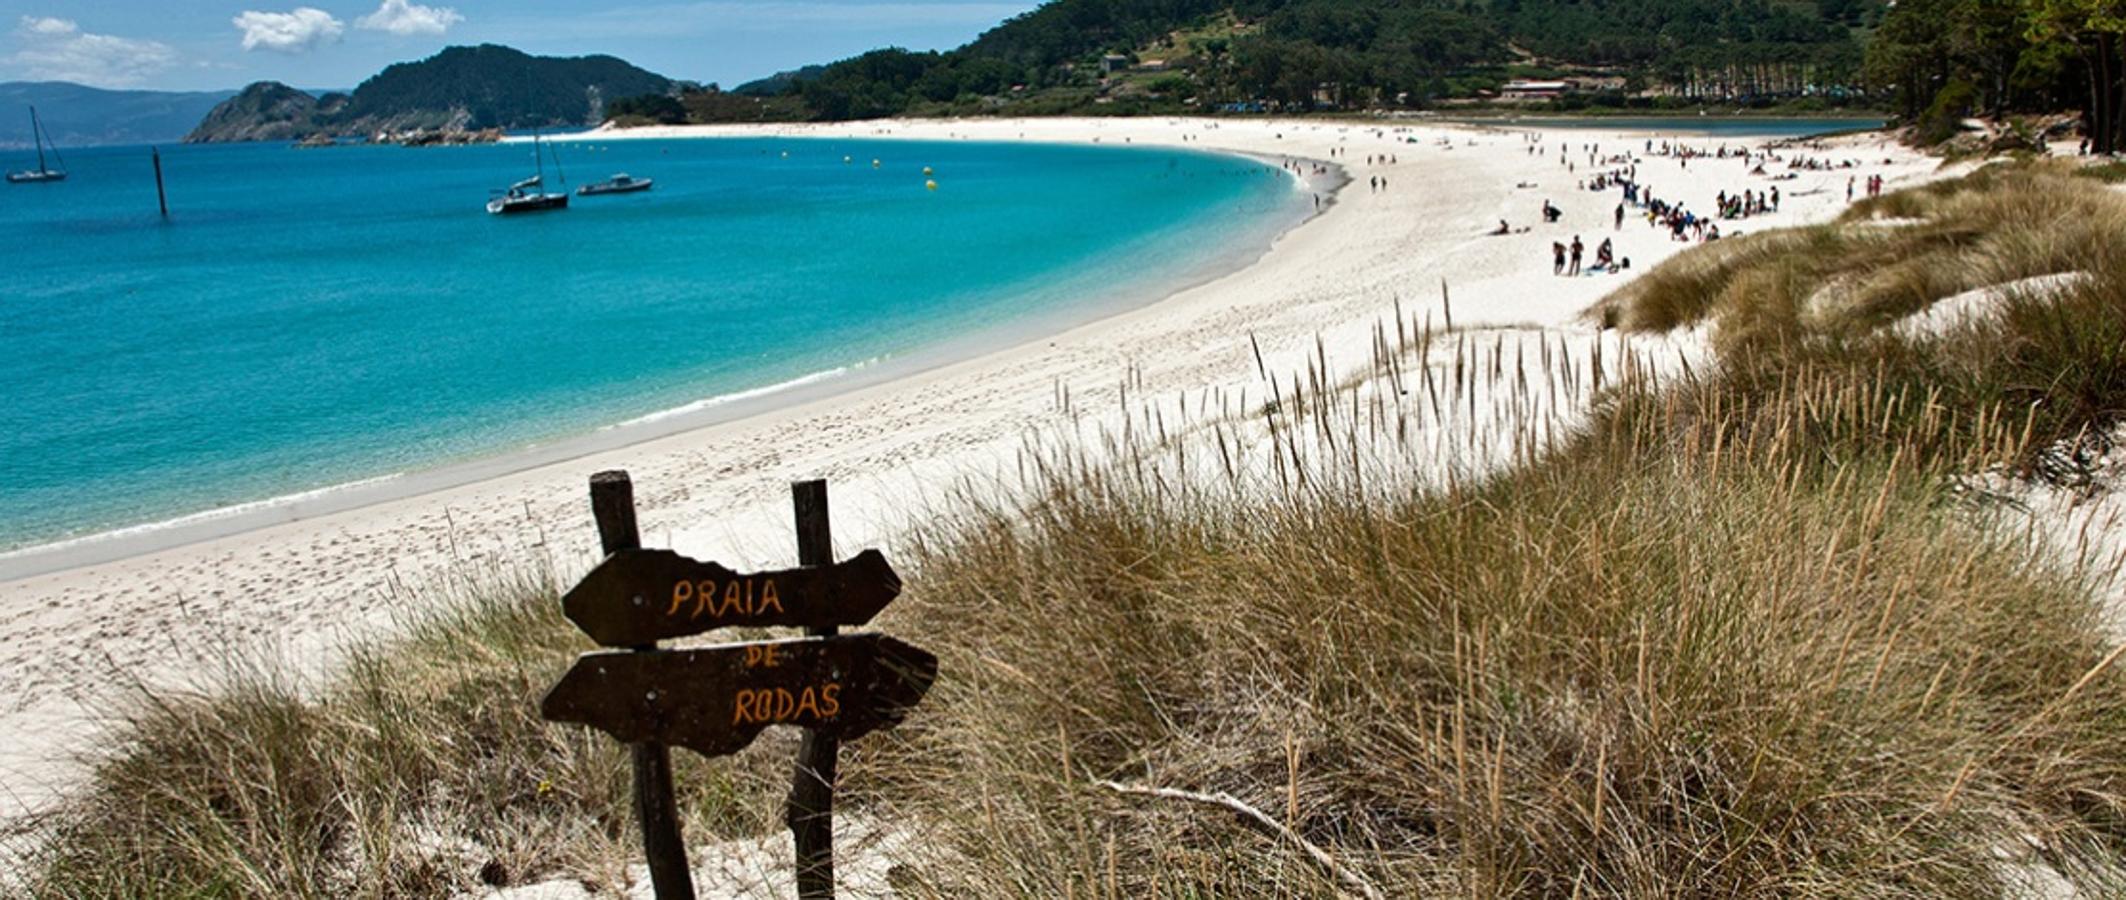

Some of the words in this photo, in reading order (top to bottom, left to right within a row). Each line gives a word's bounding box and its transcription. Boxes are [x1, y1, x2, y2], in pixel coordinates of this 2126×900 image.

[667, 580, 784, 618] PRAIA
[746, 644, 781, 667] DE
[734, 684, 840, 724] RODAS
